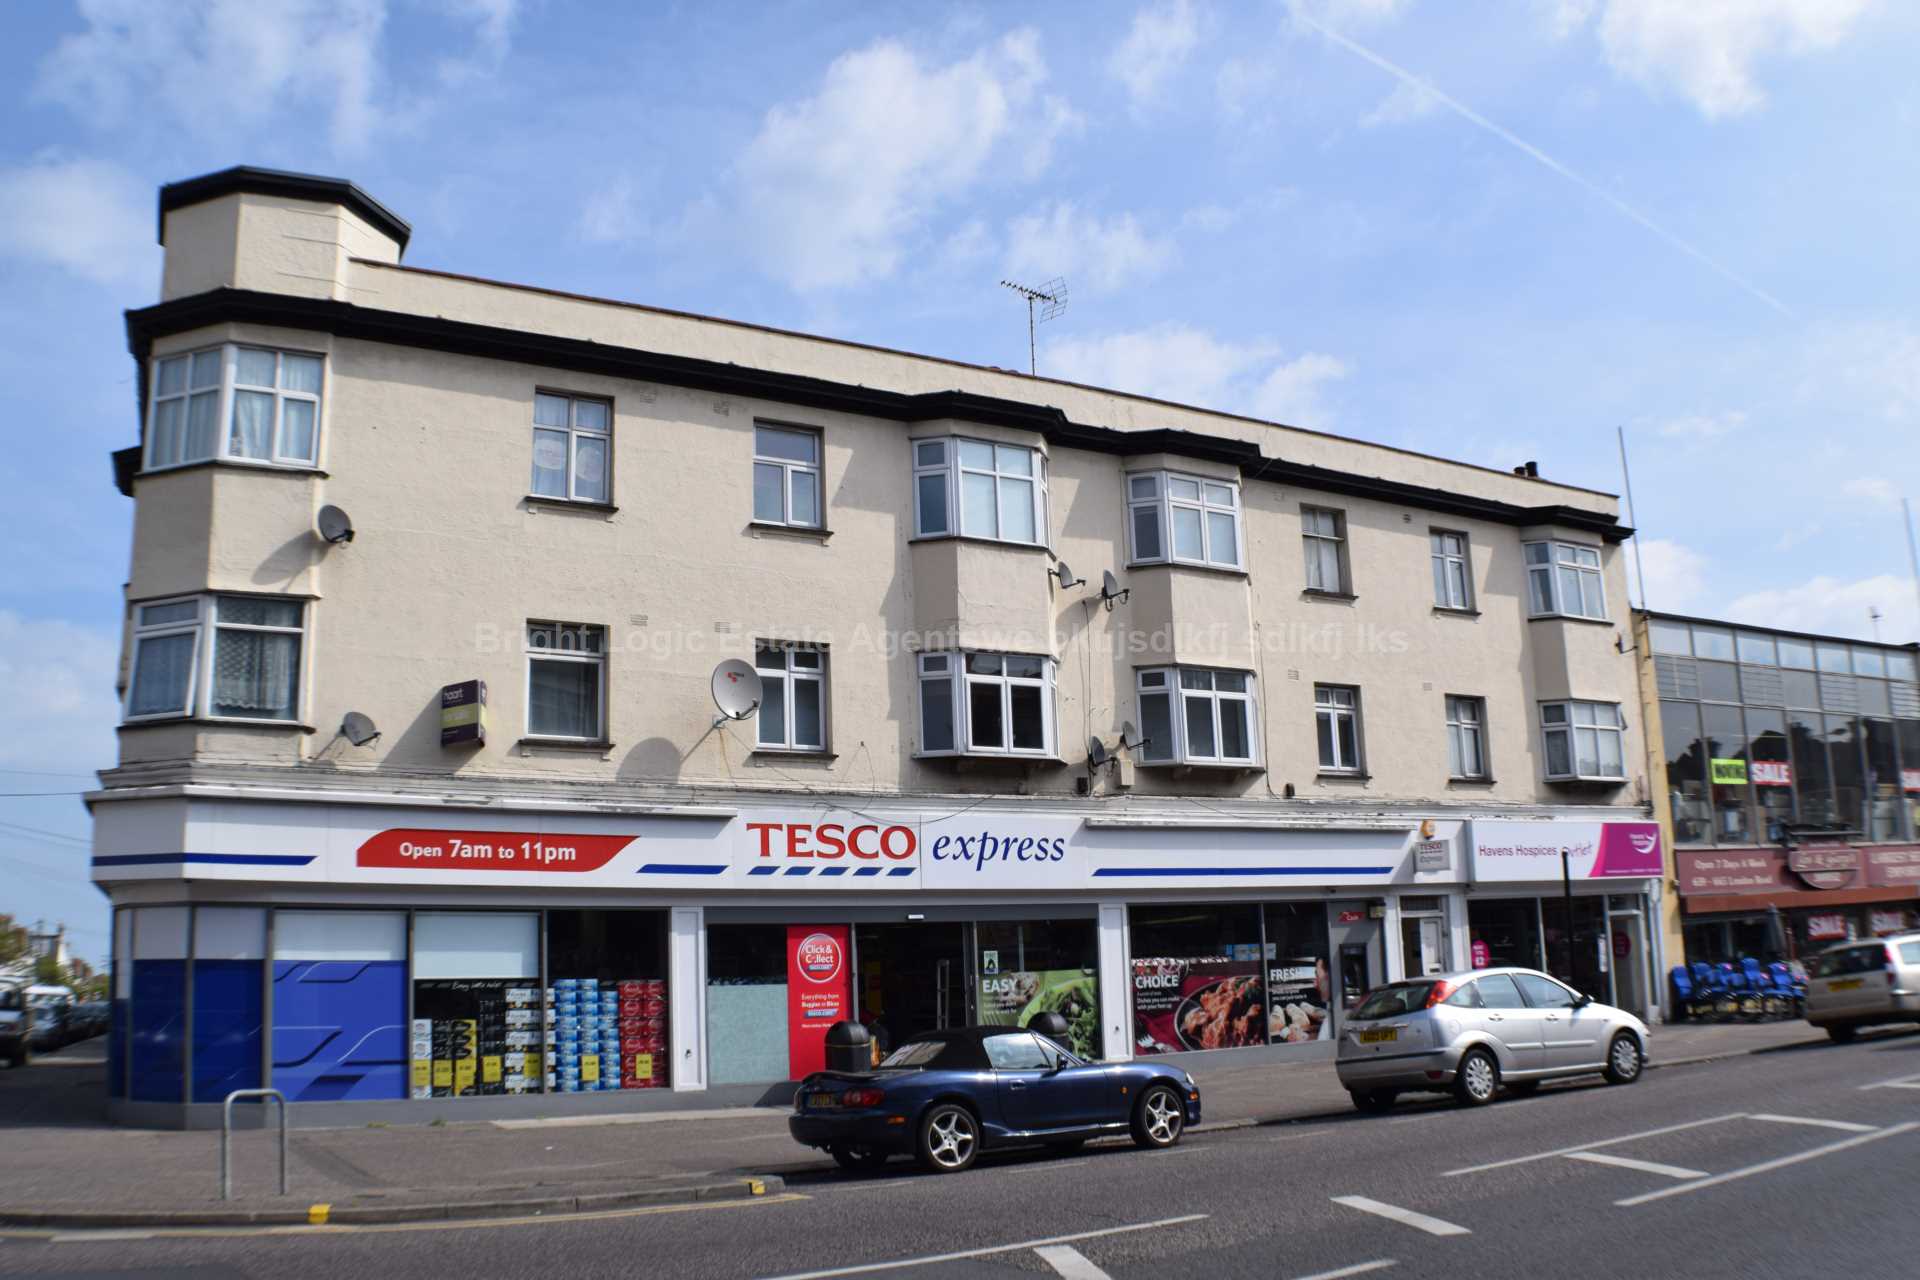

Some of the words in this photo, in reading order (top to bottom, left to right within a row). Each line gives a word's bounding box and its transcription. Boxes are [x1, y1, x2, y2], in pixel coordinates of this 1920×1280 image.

[1752, 762, 1790, 783] SALE
[400, 842, 442, 859] Open
[448, 840, 492, 858] 7am
[498, 846, 514, 859] to
[521, 841, 576, 864] 11pm
[746, 823, 917, 860] TESCO
[932, 832, 1065, 871] express
[1479, 845, 1513, 856] Havens
[1515, 845, 1557, 858] Hospices
[1808, 914, 1845, 936] SALE
[805, 944, 825, 954] Click
[1271, 967, 1304, 981] FRES
[982, 979, 1017, 992] EASY
[1136, 975, 1179, 988] CHOICE
